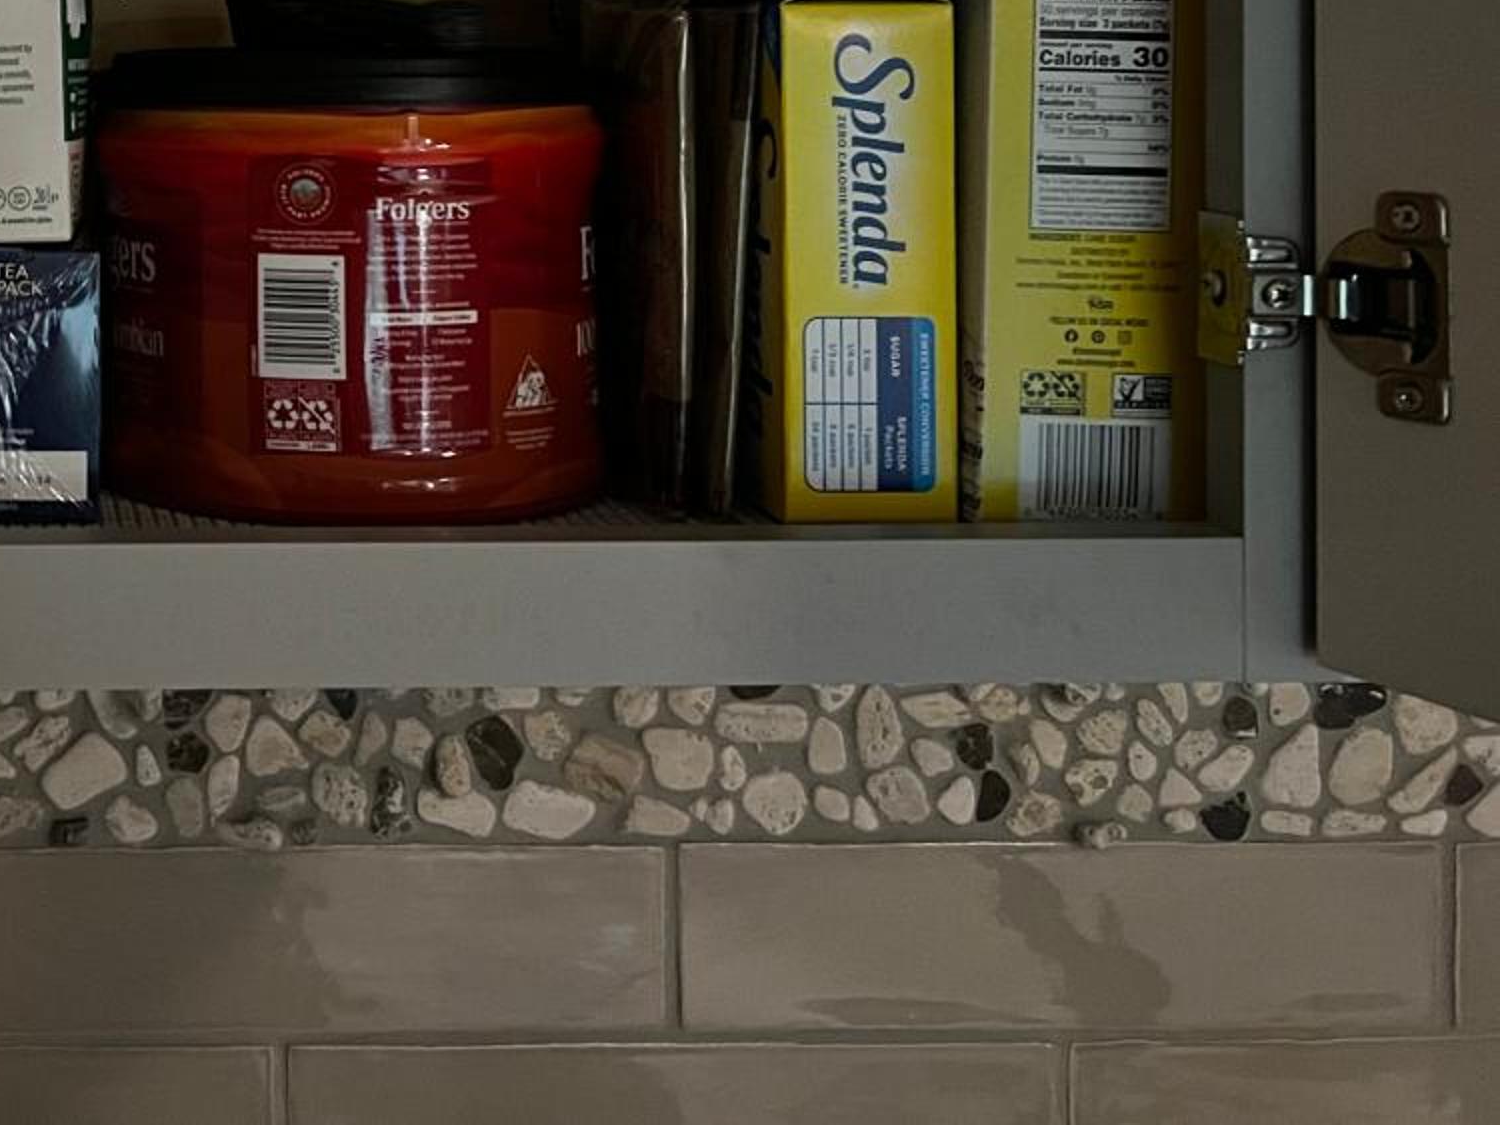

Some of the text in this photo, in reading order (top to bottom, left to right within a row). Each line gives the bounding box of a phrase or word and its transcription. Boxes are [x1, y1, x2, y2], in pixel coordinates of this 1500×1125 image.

[1039, 47, 1169, 68] Calories 30
[831, 32, 915, 286] Splenda
[376, 195, 472, 225] Folgers
[889, 335, 902, 378] SUGAR
[895, 416, 908, 472] SPLENDA
